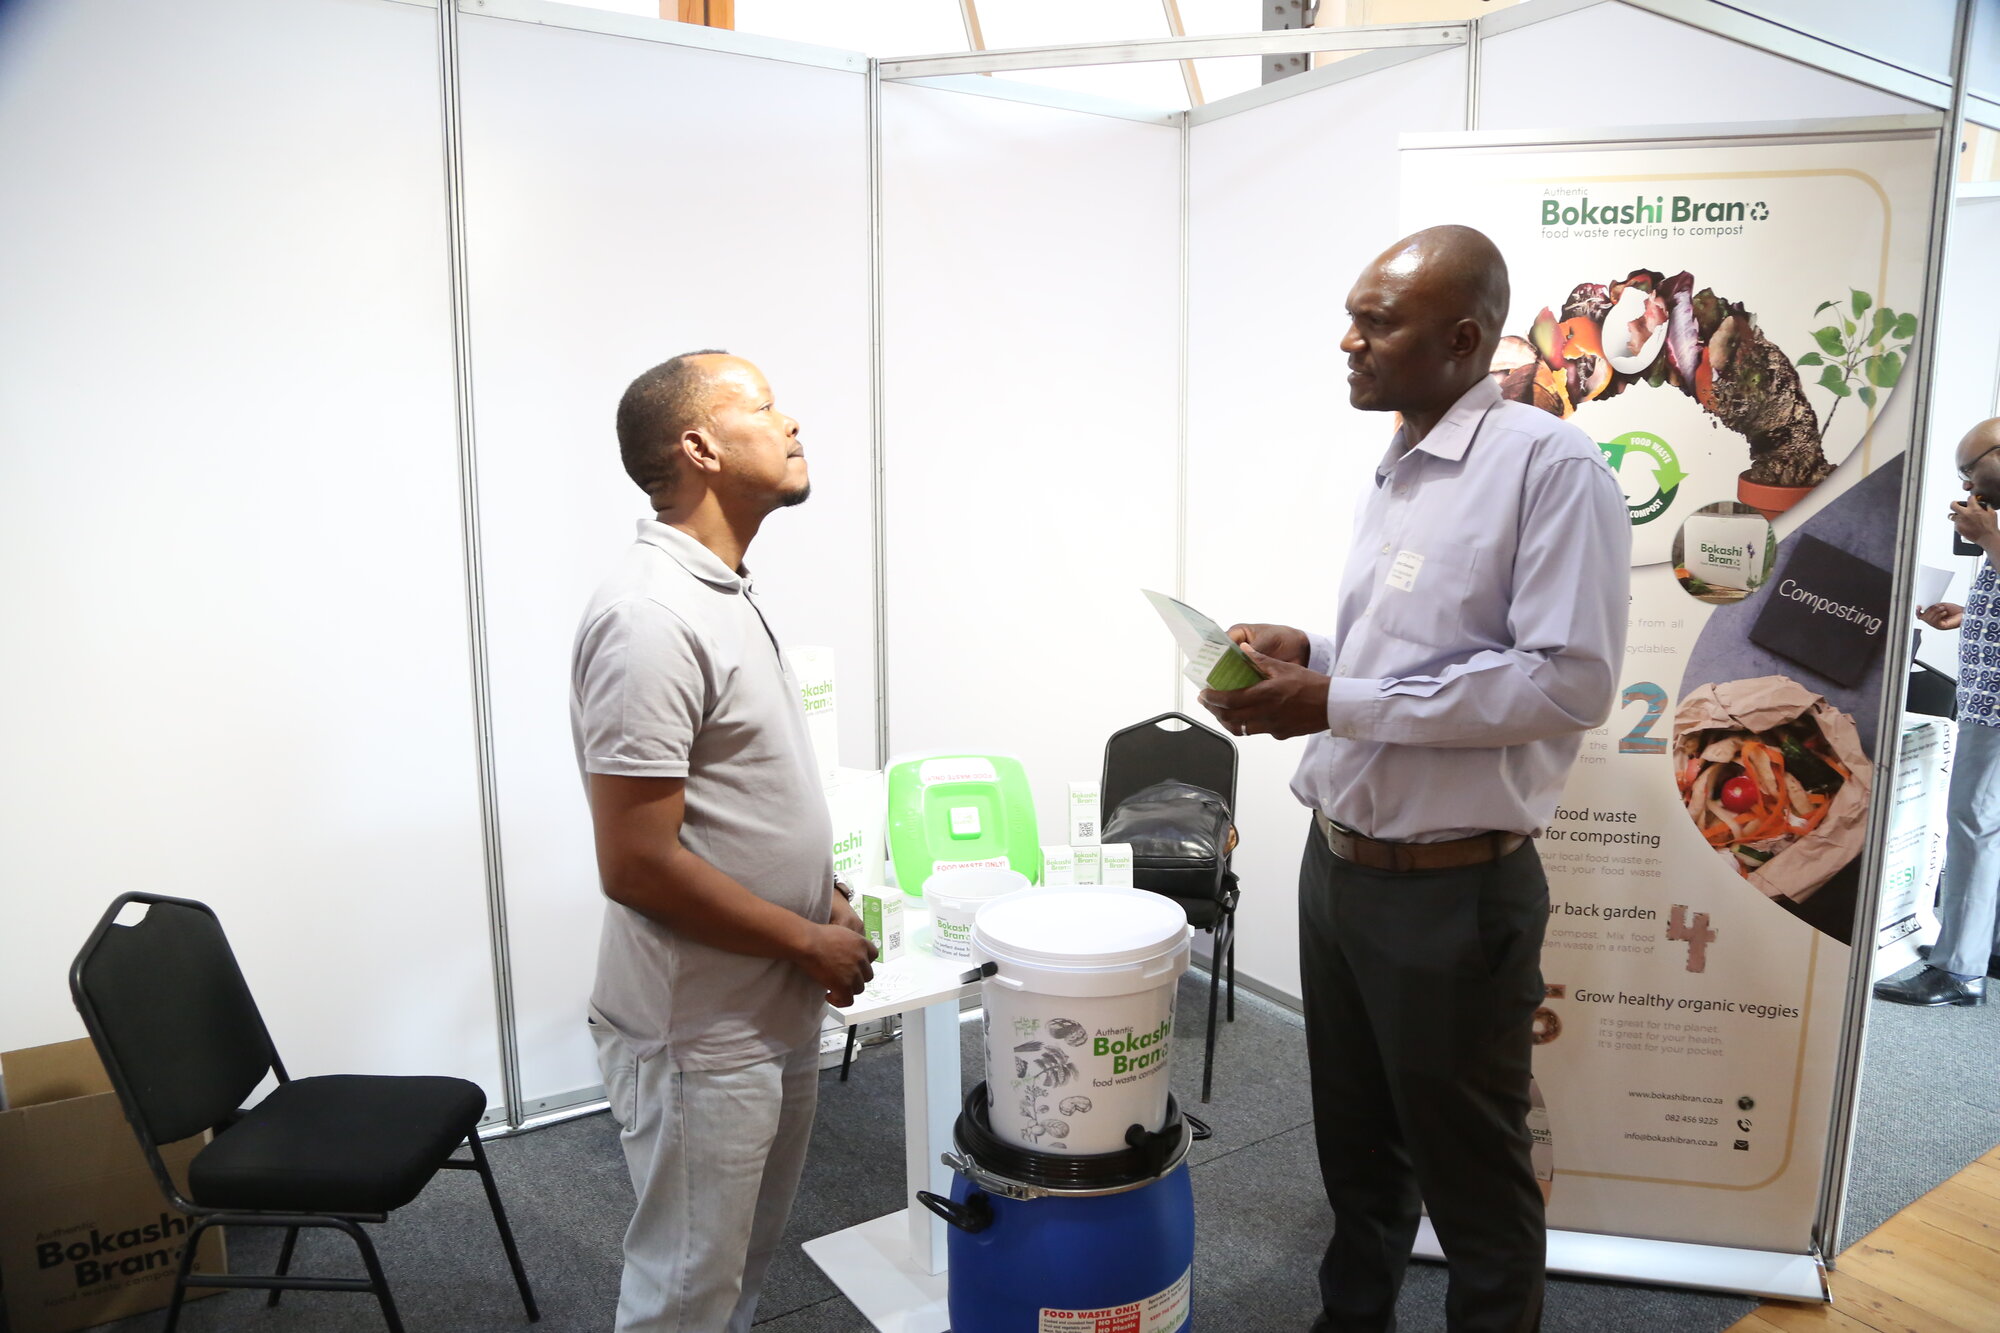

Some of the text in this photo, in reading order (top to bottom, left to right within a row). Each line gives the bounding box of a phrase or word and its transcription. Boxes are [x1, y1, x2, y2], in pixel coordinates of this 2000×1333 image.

[1544, 187, 1588, 197] Authentic
[1542, 196, 1745, 226] Bokashi Bran
[1542, 224, 1743, 240] food waste recycling to compost
[1630, 437, 1673, 464] FOOD WASTE
[1630, 498, 1664, 518] COMPOST
[1700, 543, 1742, 556] Bokashi
[1708, 554, 1732, 565] Bran
[1779, 579, 1882, 635] Composting
[1638, 618, 1665, 628] from
[1671, 619, 1684, 628] all
[1626, 644, 1678, 655] cyclables.
[801, 680, 832, 698] okashi
[1618, 682, 1668, 754] 2
[1590, 742, 1608, 750] the
[1580, 754, 1606, 764] from
[1554, 806, 1637, 823] food waste
[832, 830, 862, 855] ashi
[1545, 826, 1661, 848] for composting
[1559, 852, 1583, 862] local
[1586, 852, 1608, 862] food
[1612, 857, 1642, 865] waste
[1572, 866, 1596, 876] your
[1601, 866, 1624, 876] food
[1630, 869, 1662, 878] waste
[1550, 902, 1656, 920] ur back garden
[943, 930, 965, 940] Bran
[1606, 931, 1625, 940] Mix
[1630, 932, 1655, 943] food
[1666, 903, 1719, 974] 4
[1563, 941, 1594, 951] waste
[1596, 942, 1606, 951] in
[1617, 944, 1640, 953] ratio
[1644, 946, 1655, 954] of
[1575, 989, 1615, 1003] Grow
[1618, 992, 1674, 1010] healthy
[1678, 998, 1735, 1014] organic
[1738, 1003, 1799, 1020] veggies
[1096, 1026, 1134, 1036] Authentic
[1600, 1018, 1616, 1026] It's
[1617, 1019, 1644, 1029] great
[1646, 1020, 1662, 1028] for
[1664, 1022, 1682, 1030] the
[1093, 1016, 1172, 1056] Bokashi
[1600, 1028, 1614, 1037] It's
[1616, 1030, 1643, 1040] great
[1646, 1031, 1661, 1040] for
[1662, 1034, 1686, 1044] your
[1598, 1040, 1614, 1048] It's
[1614, 1042, 1641, 1052] great
[1644, 1042, 1660, 1051] for
[1661, 1044, 1684, 1054] your
[1113, 1048, 1159, 1074] Bran
[1092, 1078, 1112, 1088] food
[1115, 1075, 1136, 1085] waste
[1628, 1090, 1723, 1104] www.bokashibran.co.za
[1665, 1114, 1718, 1126] 082 456 9225
[1624, 1132, 1718, 1147] info@bokashibran.co.za
[36, 1220, 96, 1241] Authentic
[74, 1248, 169, 1288] Bran
[1044, 1303, 1141, 1319] FOOD WASTE ONLY
[1112, 1314, 1138, 1324] Liquids
[1112, 1322, 1136, 1332] Plastic
